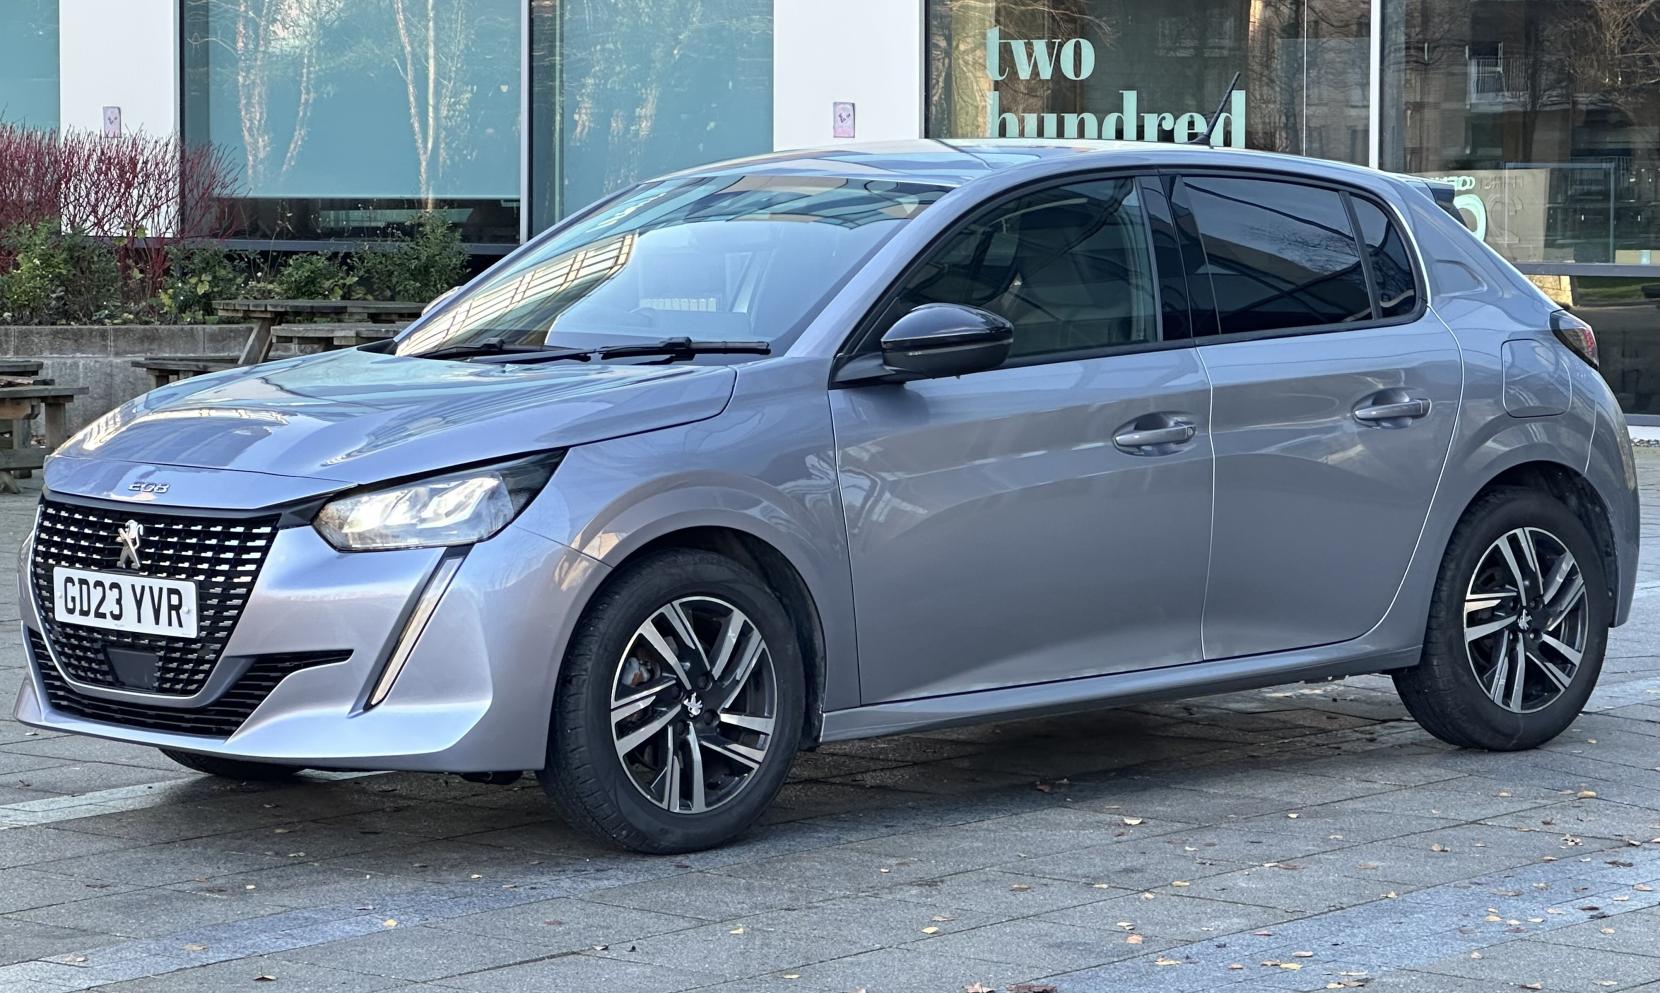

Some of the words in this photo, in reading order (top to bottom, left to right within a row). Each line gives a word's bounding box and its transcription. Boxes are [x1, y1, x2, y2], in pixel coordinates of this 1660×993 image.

[986, 25, 1096, 81] two
[985, 90, 1246, 149] hundred
[63, 576, 123, 622] GD23
[130, 583, 184, 629] YVR
